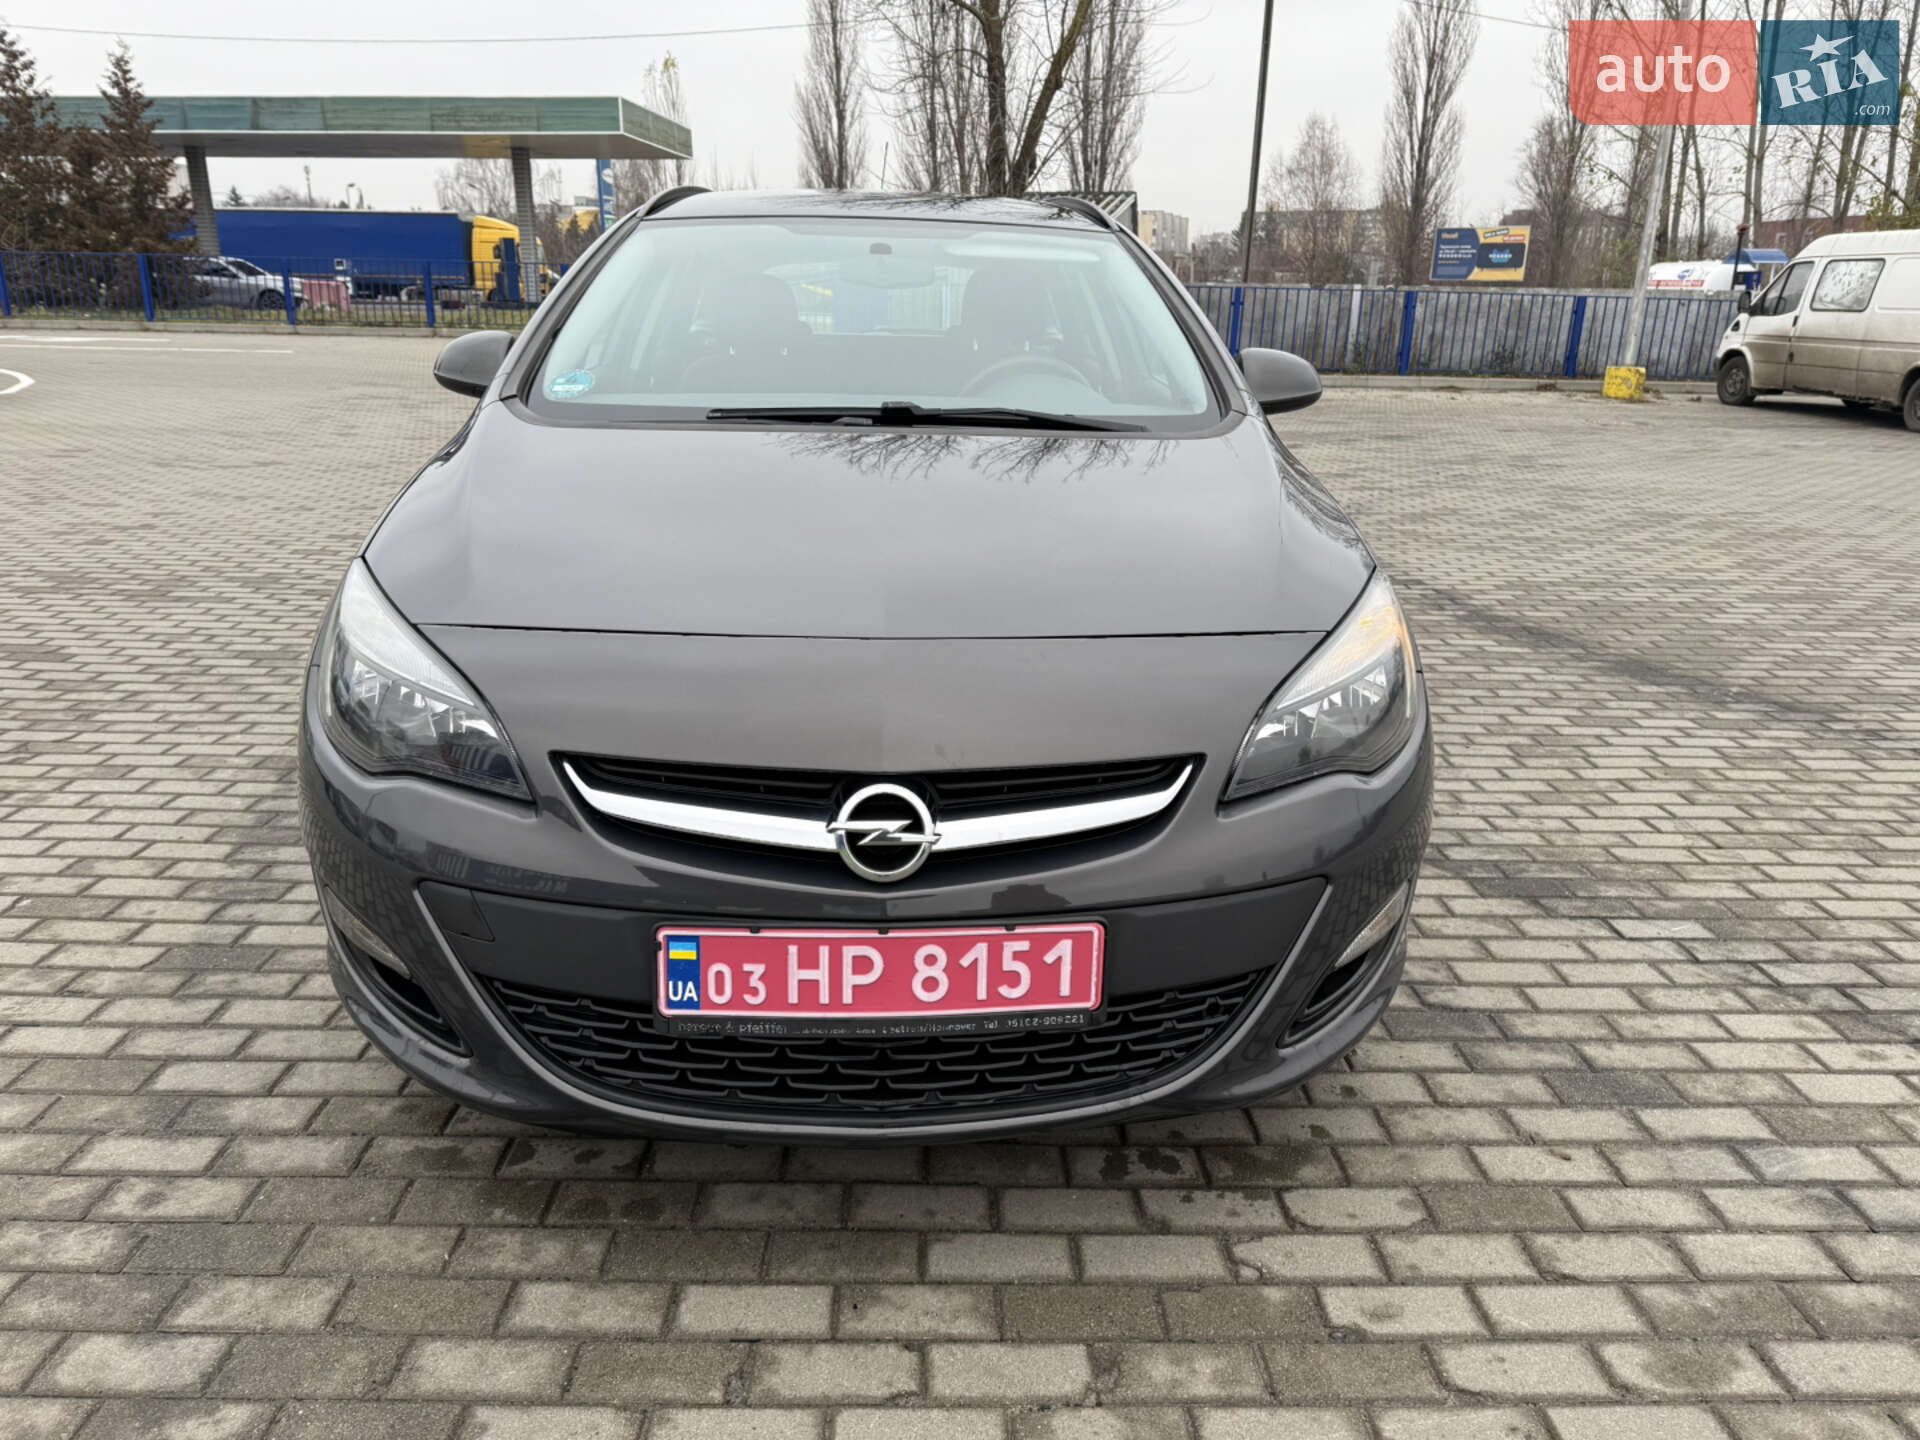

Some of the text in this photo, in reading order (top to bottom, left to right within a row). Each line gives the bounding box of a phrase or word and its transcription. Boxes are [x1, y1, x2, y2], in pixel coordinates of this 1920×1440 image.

[668, 980, 698, 1002] UA
[707, 938, 1073, 1005] 03 HP 8151
